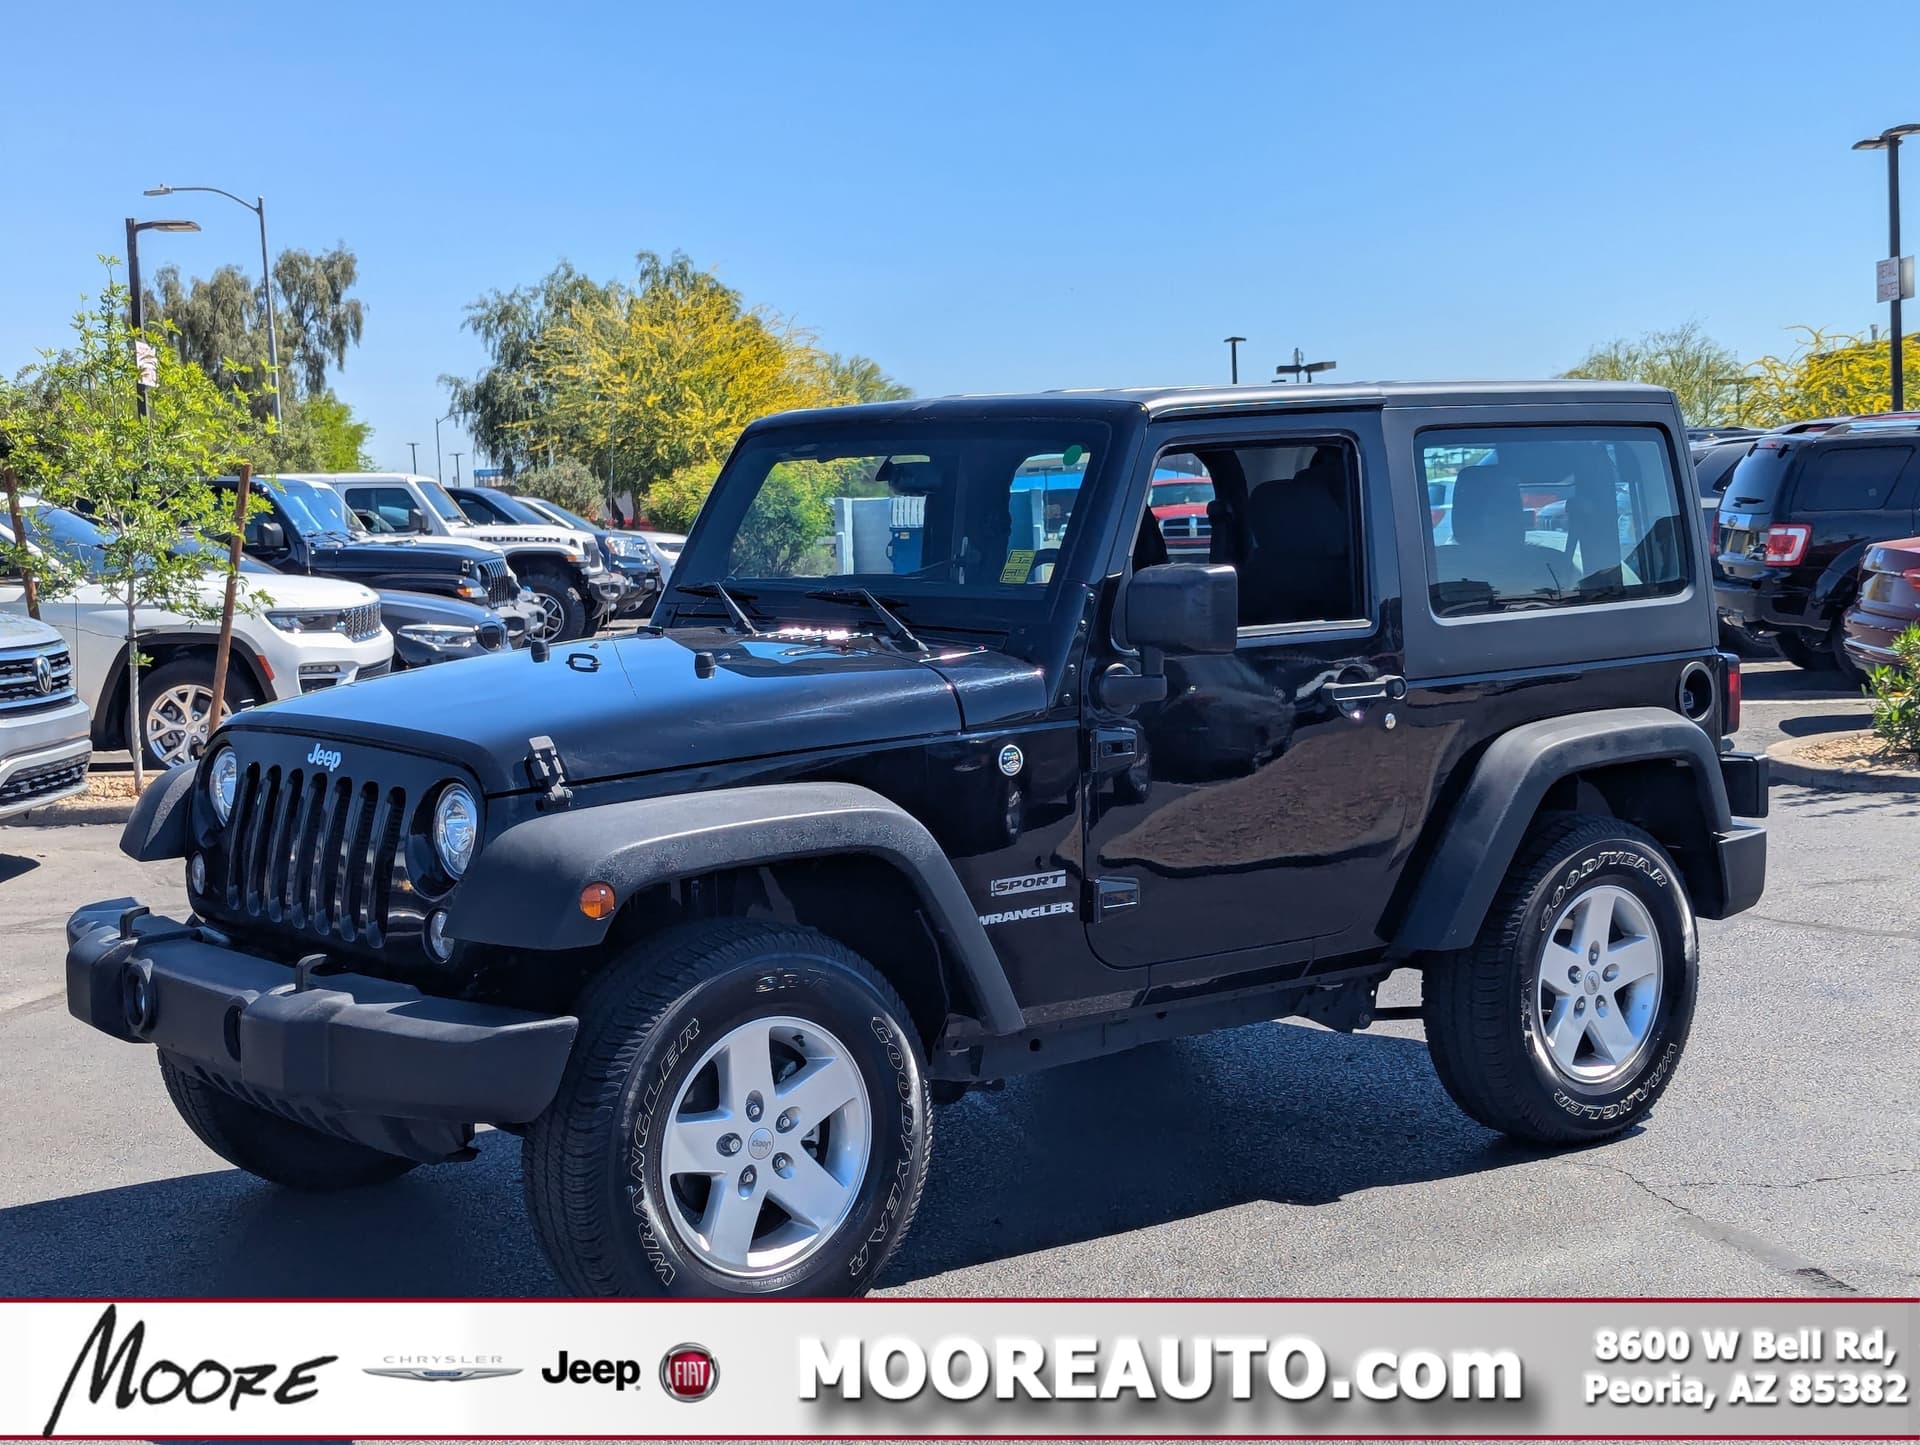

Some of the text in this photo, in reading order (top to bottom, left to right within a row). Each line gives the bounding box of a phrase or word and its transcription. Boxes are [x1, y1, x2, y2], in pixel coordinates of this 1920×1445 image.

[307, 743, 342, 772] Jeep
[993, 873, 1062, 892] SPORT
[1540, 851, 1668, 932] GOODYEAR
[1553, 1043, 1678, 1120] WRANGLER
[630, 1017, 700, 1287] WRANGLER
[850, 1015, 916, 1276] GOODYEAR
